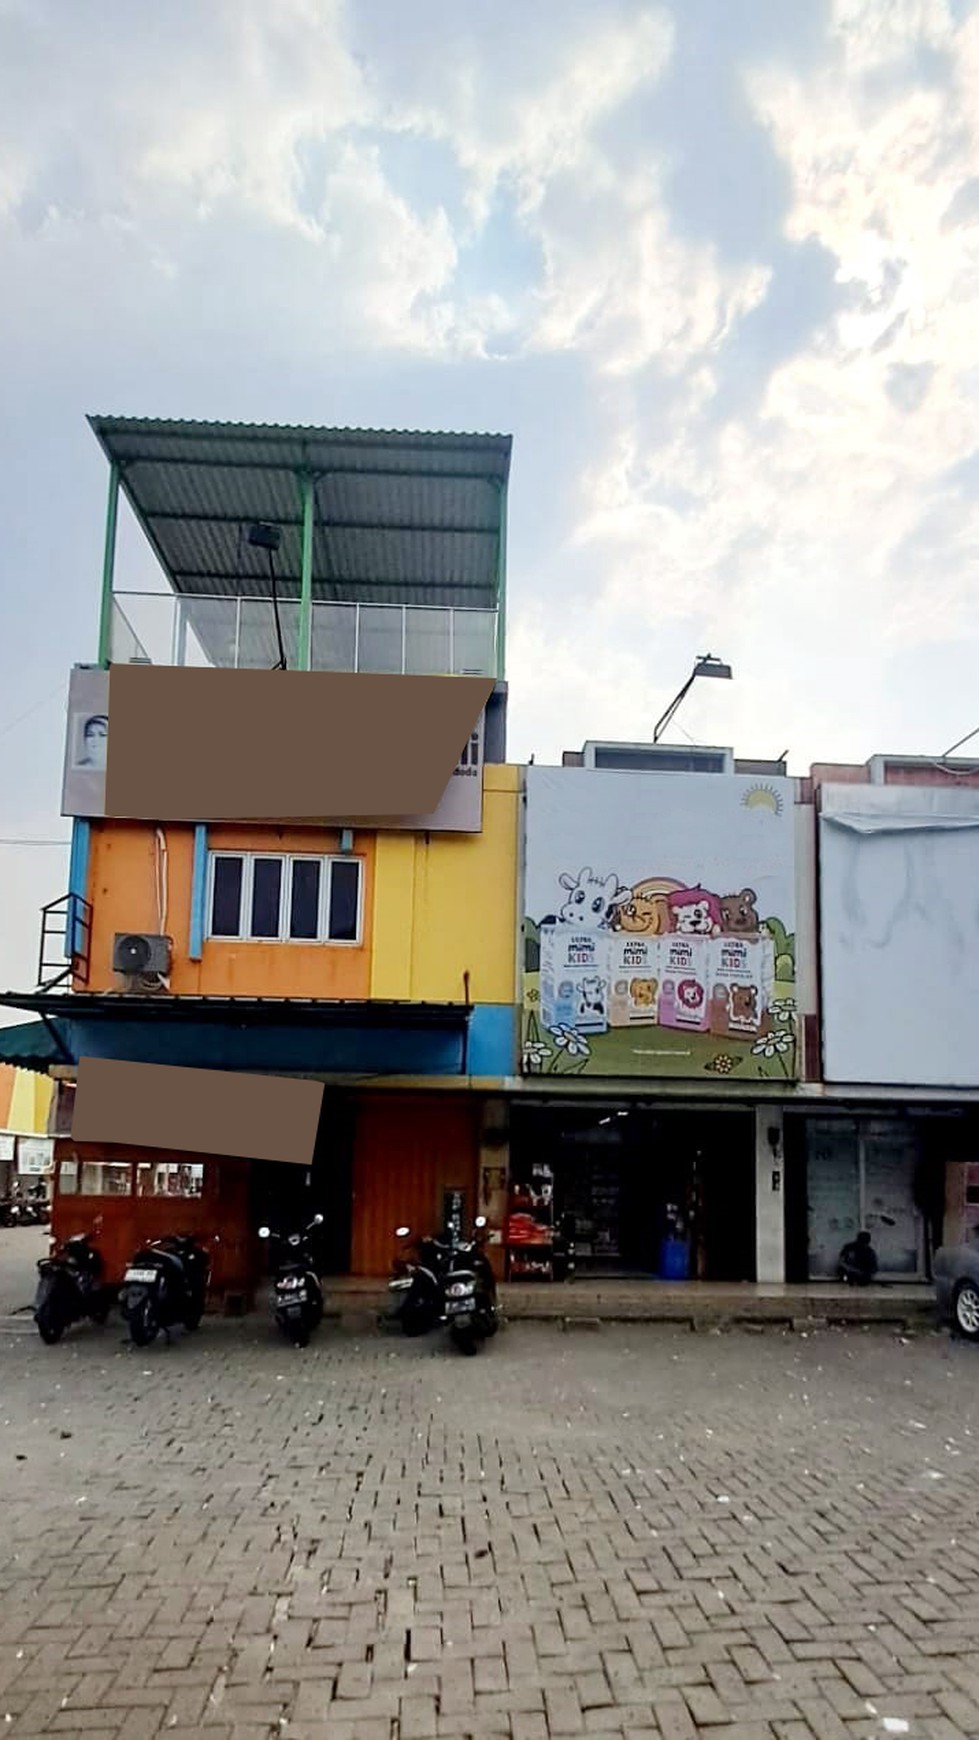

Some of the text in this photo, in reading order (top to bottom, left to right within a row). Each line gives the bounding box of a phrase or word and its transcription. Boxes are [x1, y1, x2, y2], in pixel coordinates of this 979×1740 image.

[568, 942, 595, 952] mimi
[624, 946, 648, 955] mimi
[670, 947, 692, 957] mimi
[721, 948, 747, 957] mimi
